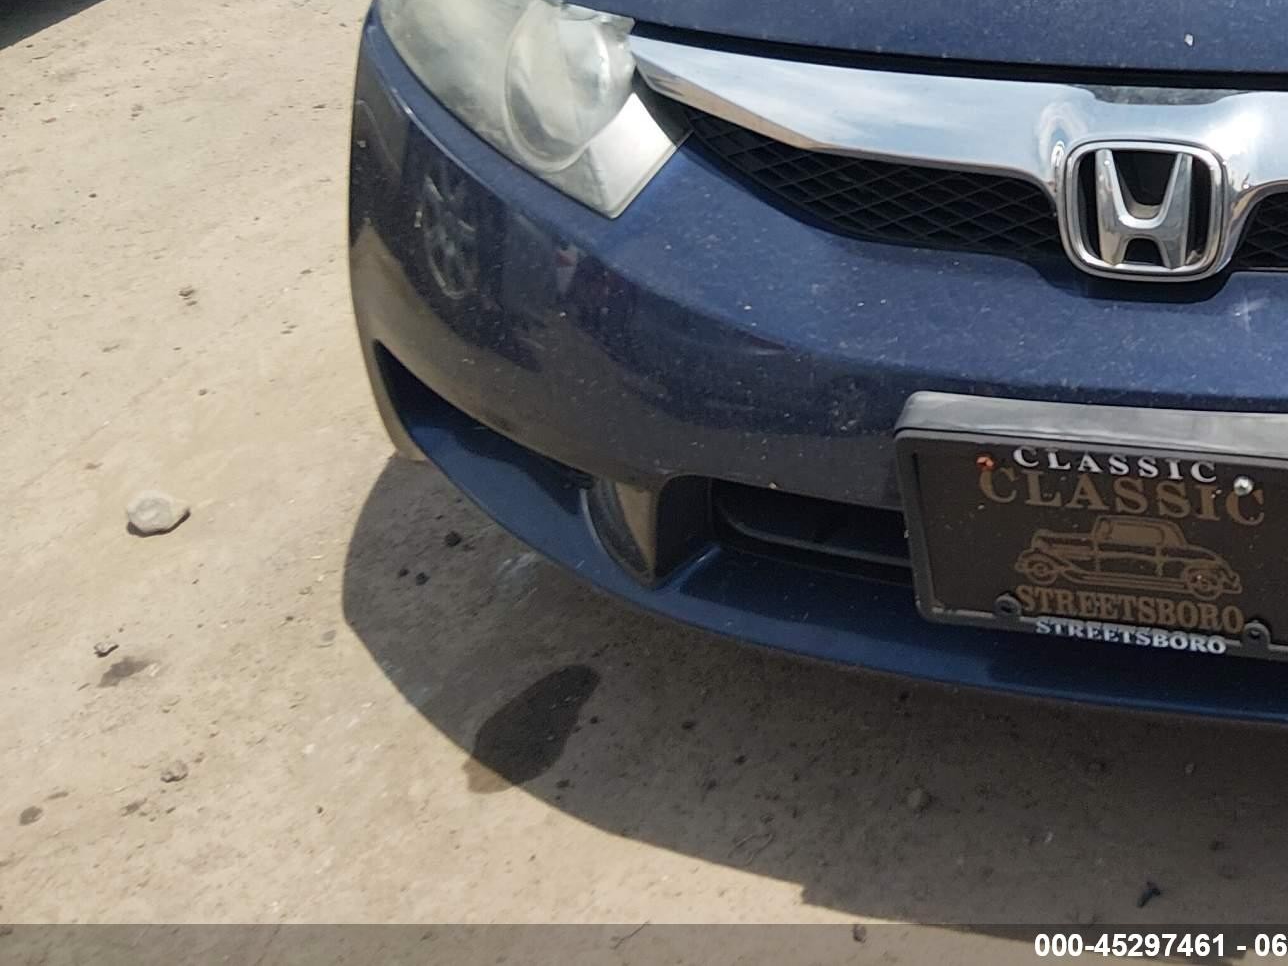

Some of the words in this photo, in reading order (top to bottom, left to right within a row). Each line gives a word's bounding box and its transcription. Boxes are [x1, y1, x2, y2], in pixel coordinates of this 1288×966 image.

[1012, 445, 1217, 483] CLASSIC
[979, 466, 1265, 526] CLASSIC
[1016, 585, 1244, 634] STREETSBORO
[1035, 618, 1227, 655] STREETSBORO
